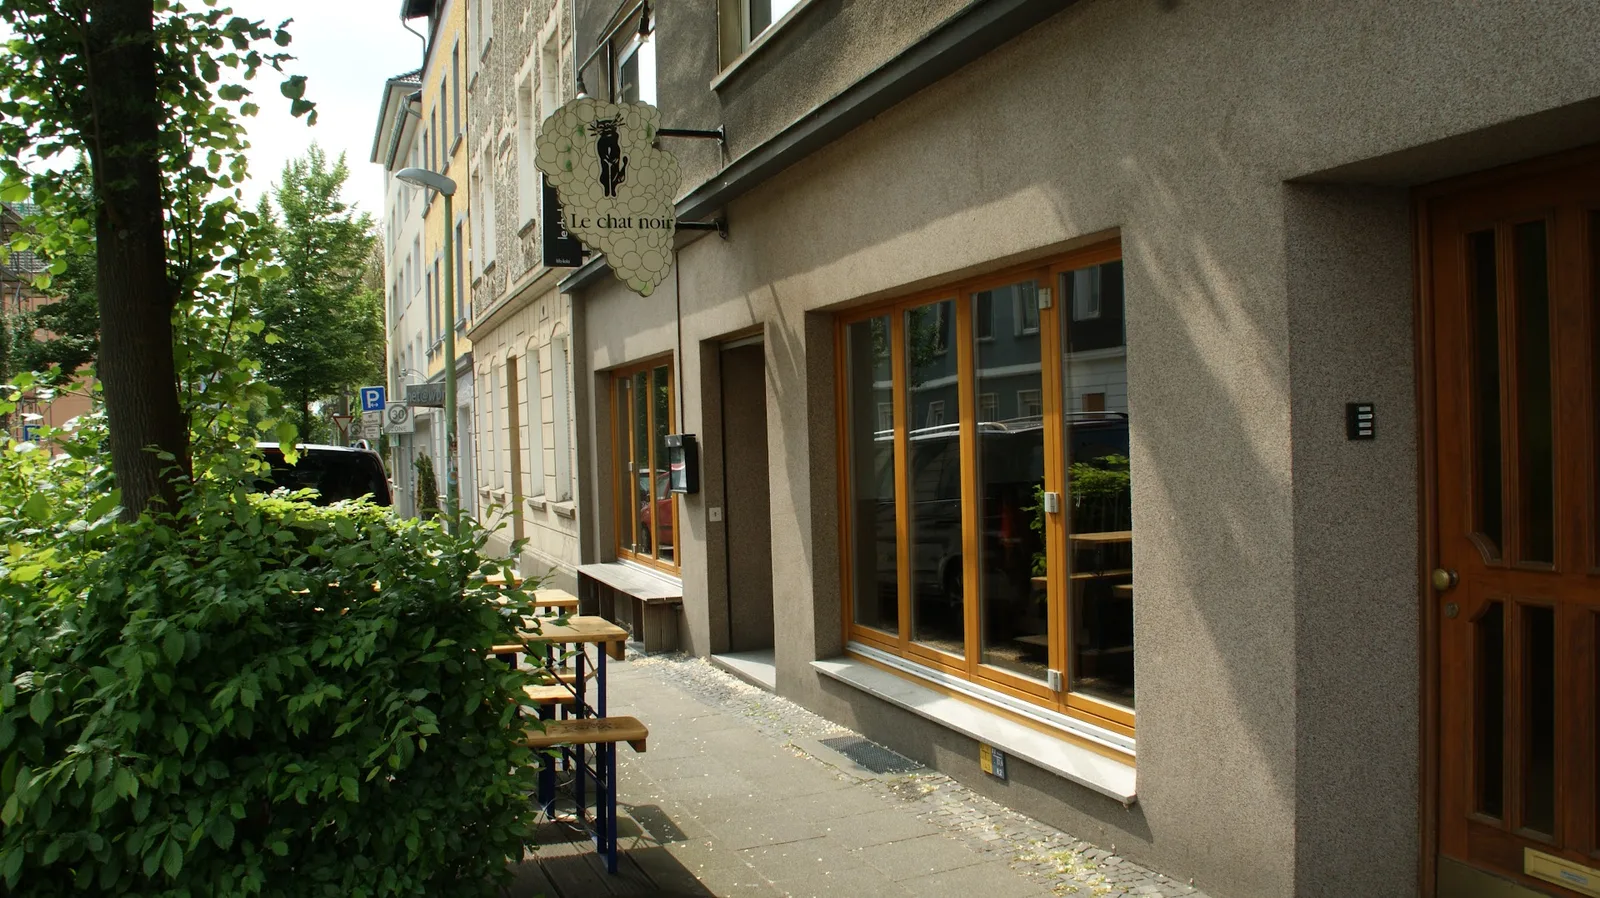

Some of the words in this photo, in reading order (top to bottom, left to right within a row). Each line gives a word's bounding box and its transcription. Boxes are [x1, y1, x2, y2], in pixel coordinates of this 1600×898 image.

[570, 213, 591, 229] Le
[596, 213, 633, 229] chat
[638, 215, 674, 230] noir
[366, 390, 380, 409] P
[392, 409, 405, 420] 30
